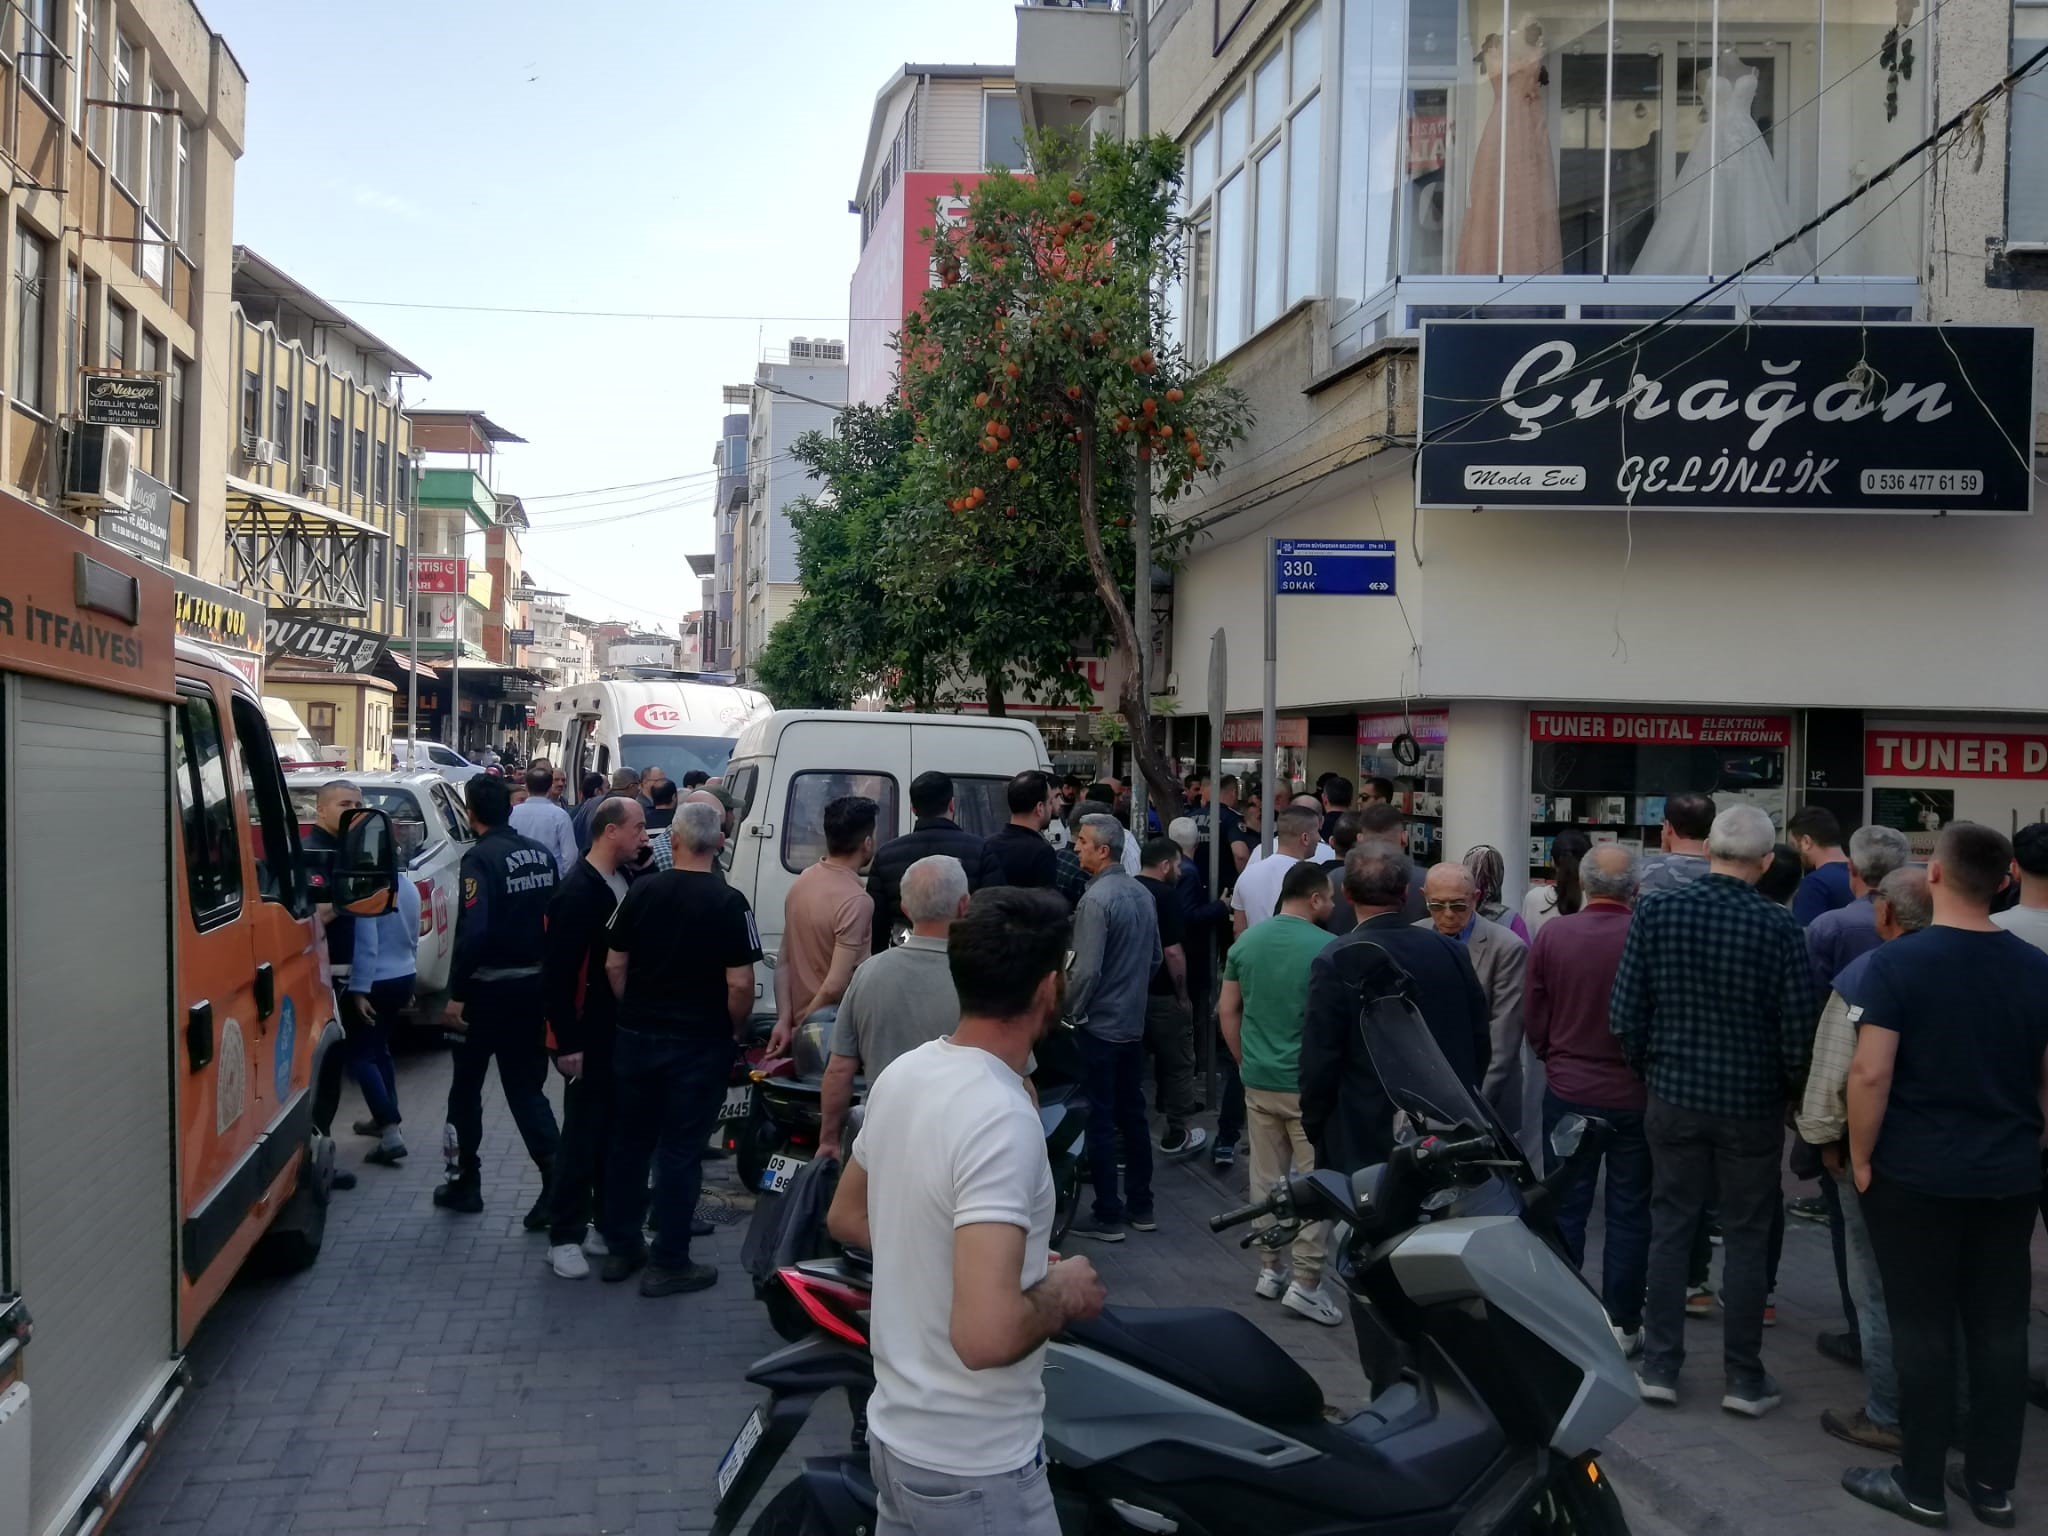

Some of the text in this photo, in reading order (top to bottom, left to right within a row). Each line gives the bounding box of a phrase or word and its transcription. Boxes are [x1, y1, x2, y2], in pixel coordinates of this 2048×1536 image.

[110, 382, 154, 397] Nurcan
[1500, 340, 1953, 450] Çırağan
[108, 409, 138, 417] SALONU
[139, 402, 158, 410] AĞDA
[1471, 469, 1580, 488] Moda Evi
[1617, 448, 1840, 503] GELİNLİK
[1866, 474, 1977, 491] 0 536 477 61 59
[1283, 561, 1317, 576] 330.
[1282, 581, 1316, 590] SOKAK
[650, 711, 680, 721] 112
[1536, 716, 1606, 737] TUNER
[1612, 718, 1694, 739] DIGITAL
[1875, 737, 2008, 773] TUNER
[505, 849, 547, 873] AYDIN
[719, 1102, 749, 1118] 2445
[770, 1157, 786, 1171] 09
